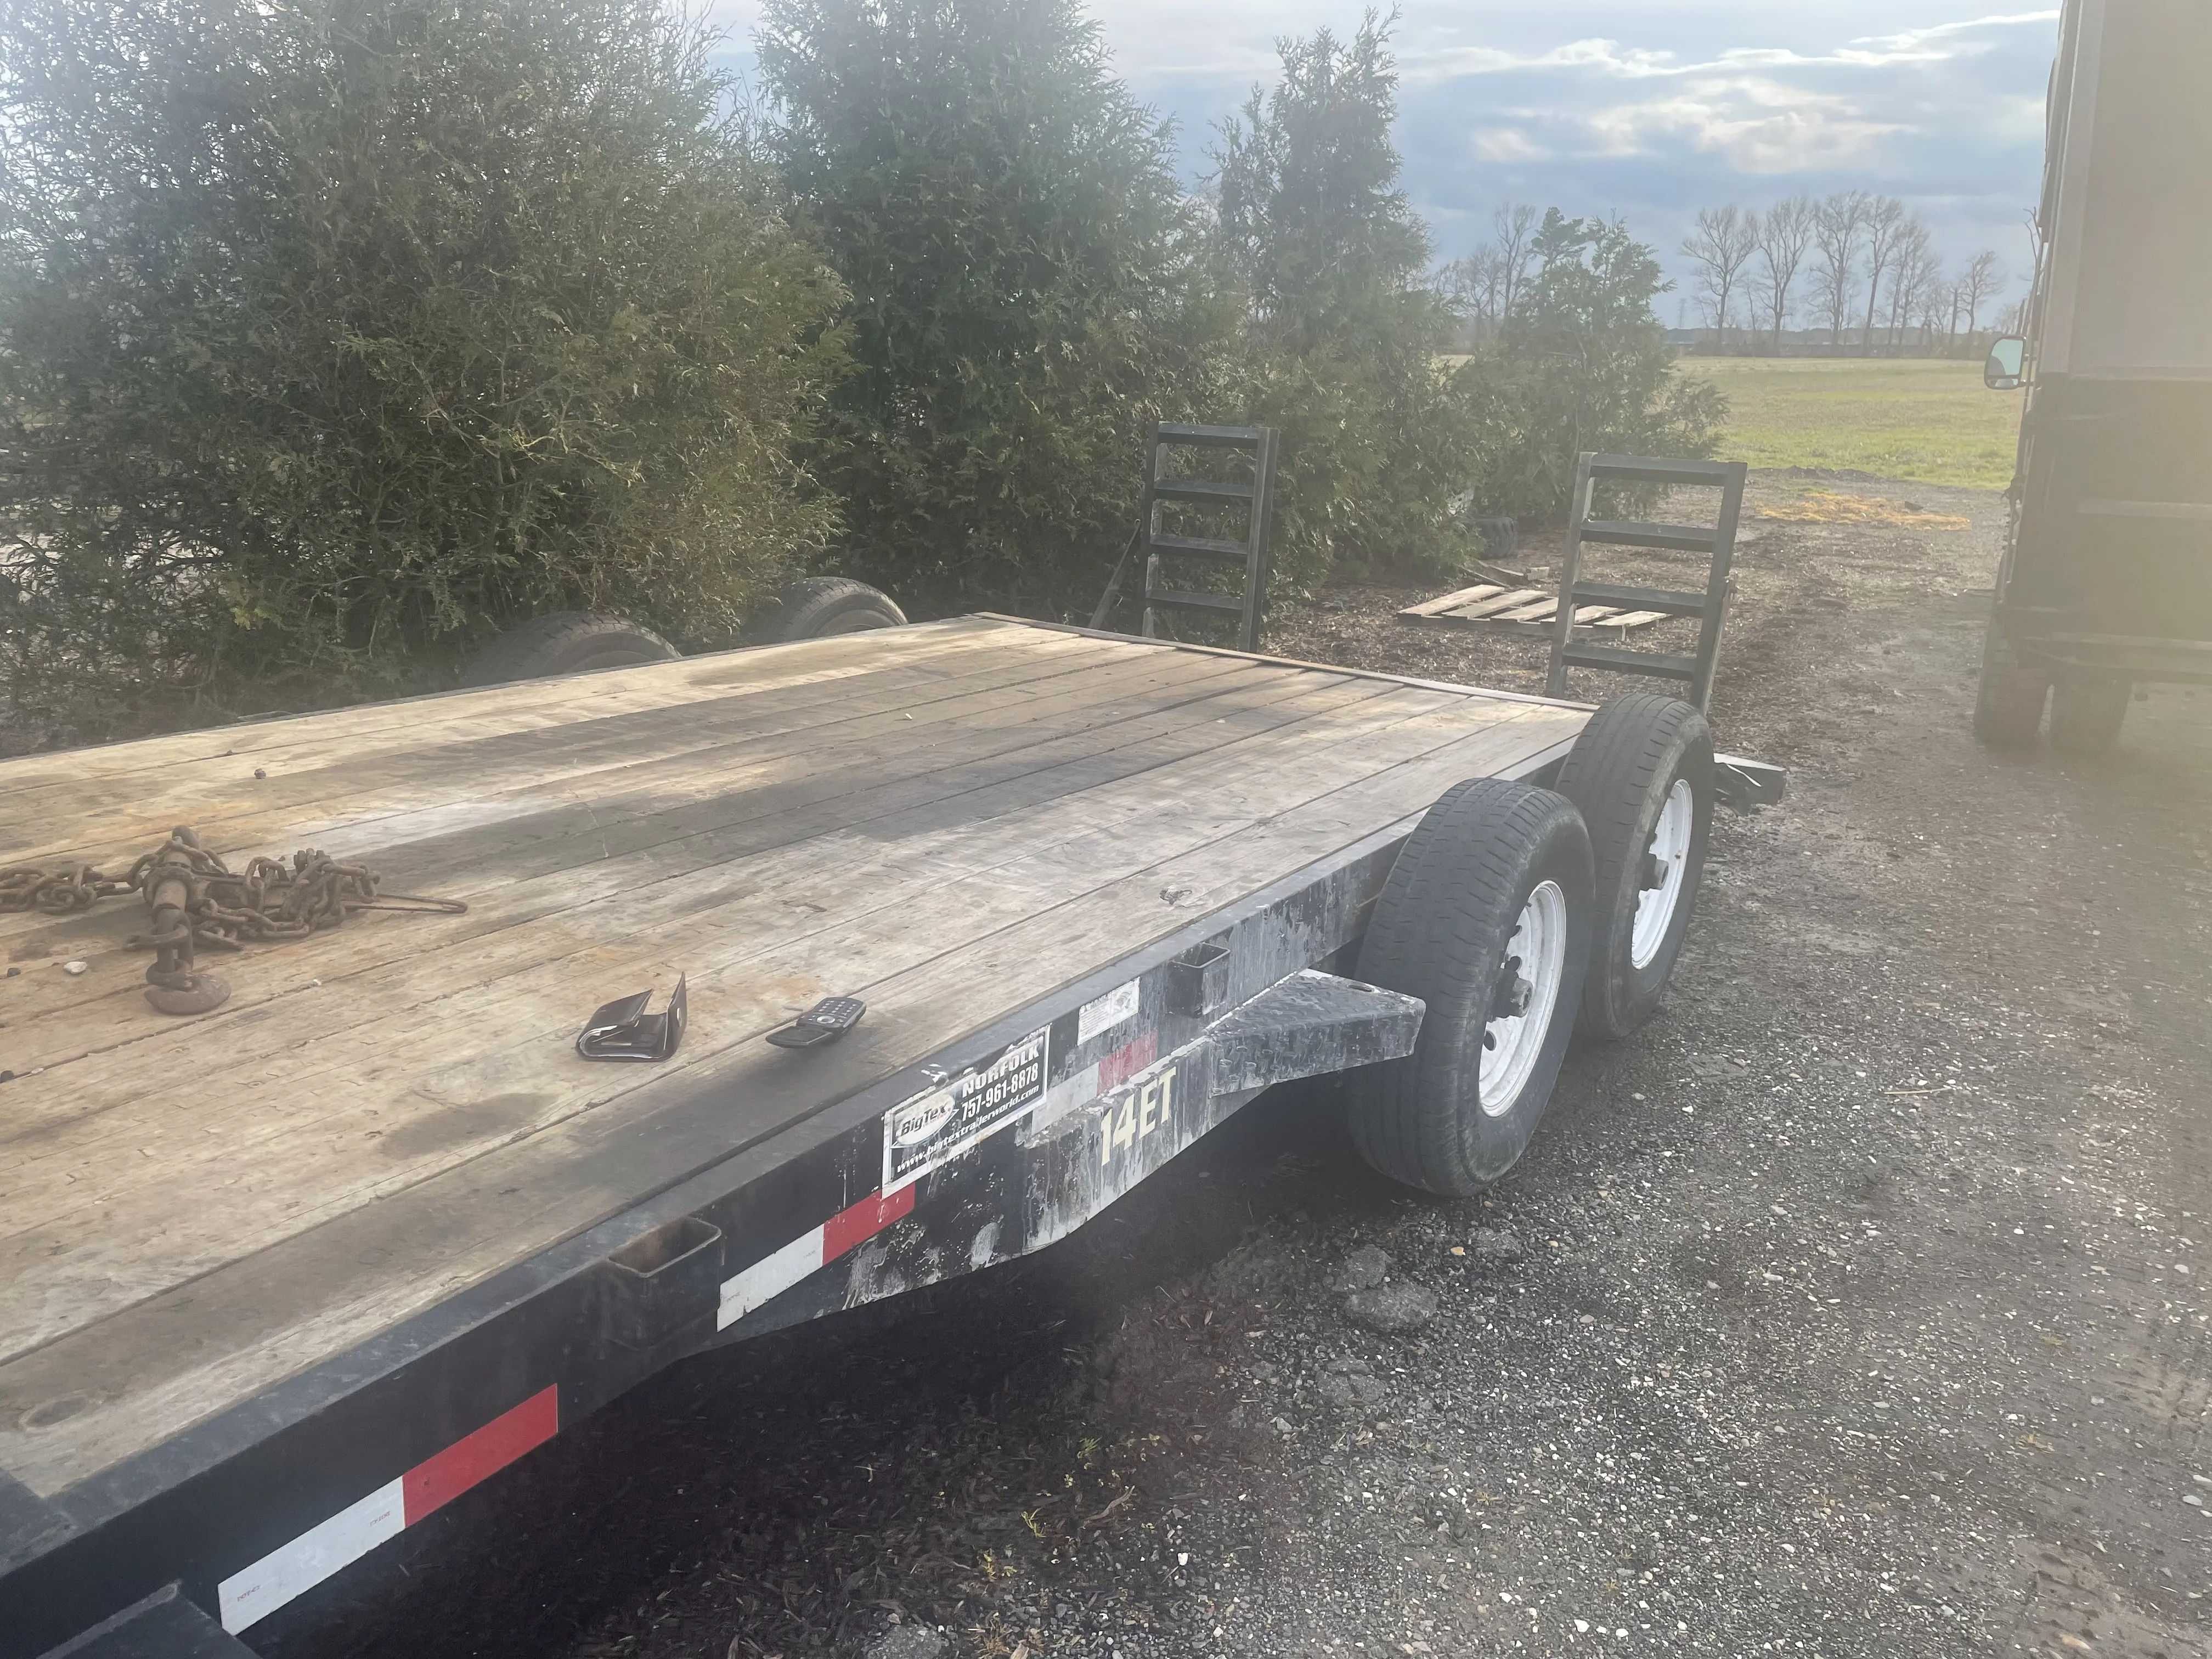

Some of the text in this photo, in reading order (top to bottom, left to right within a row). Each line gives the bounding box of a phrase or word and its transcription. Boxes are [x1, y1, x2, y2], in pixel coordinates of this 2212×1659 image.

[962, 1044, 1039, 1098] NORFOLK
[962, 1062, 1039, 1122] 757-961-8878
[1101, 1066, 1176, 1167] 14ET
